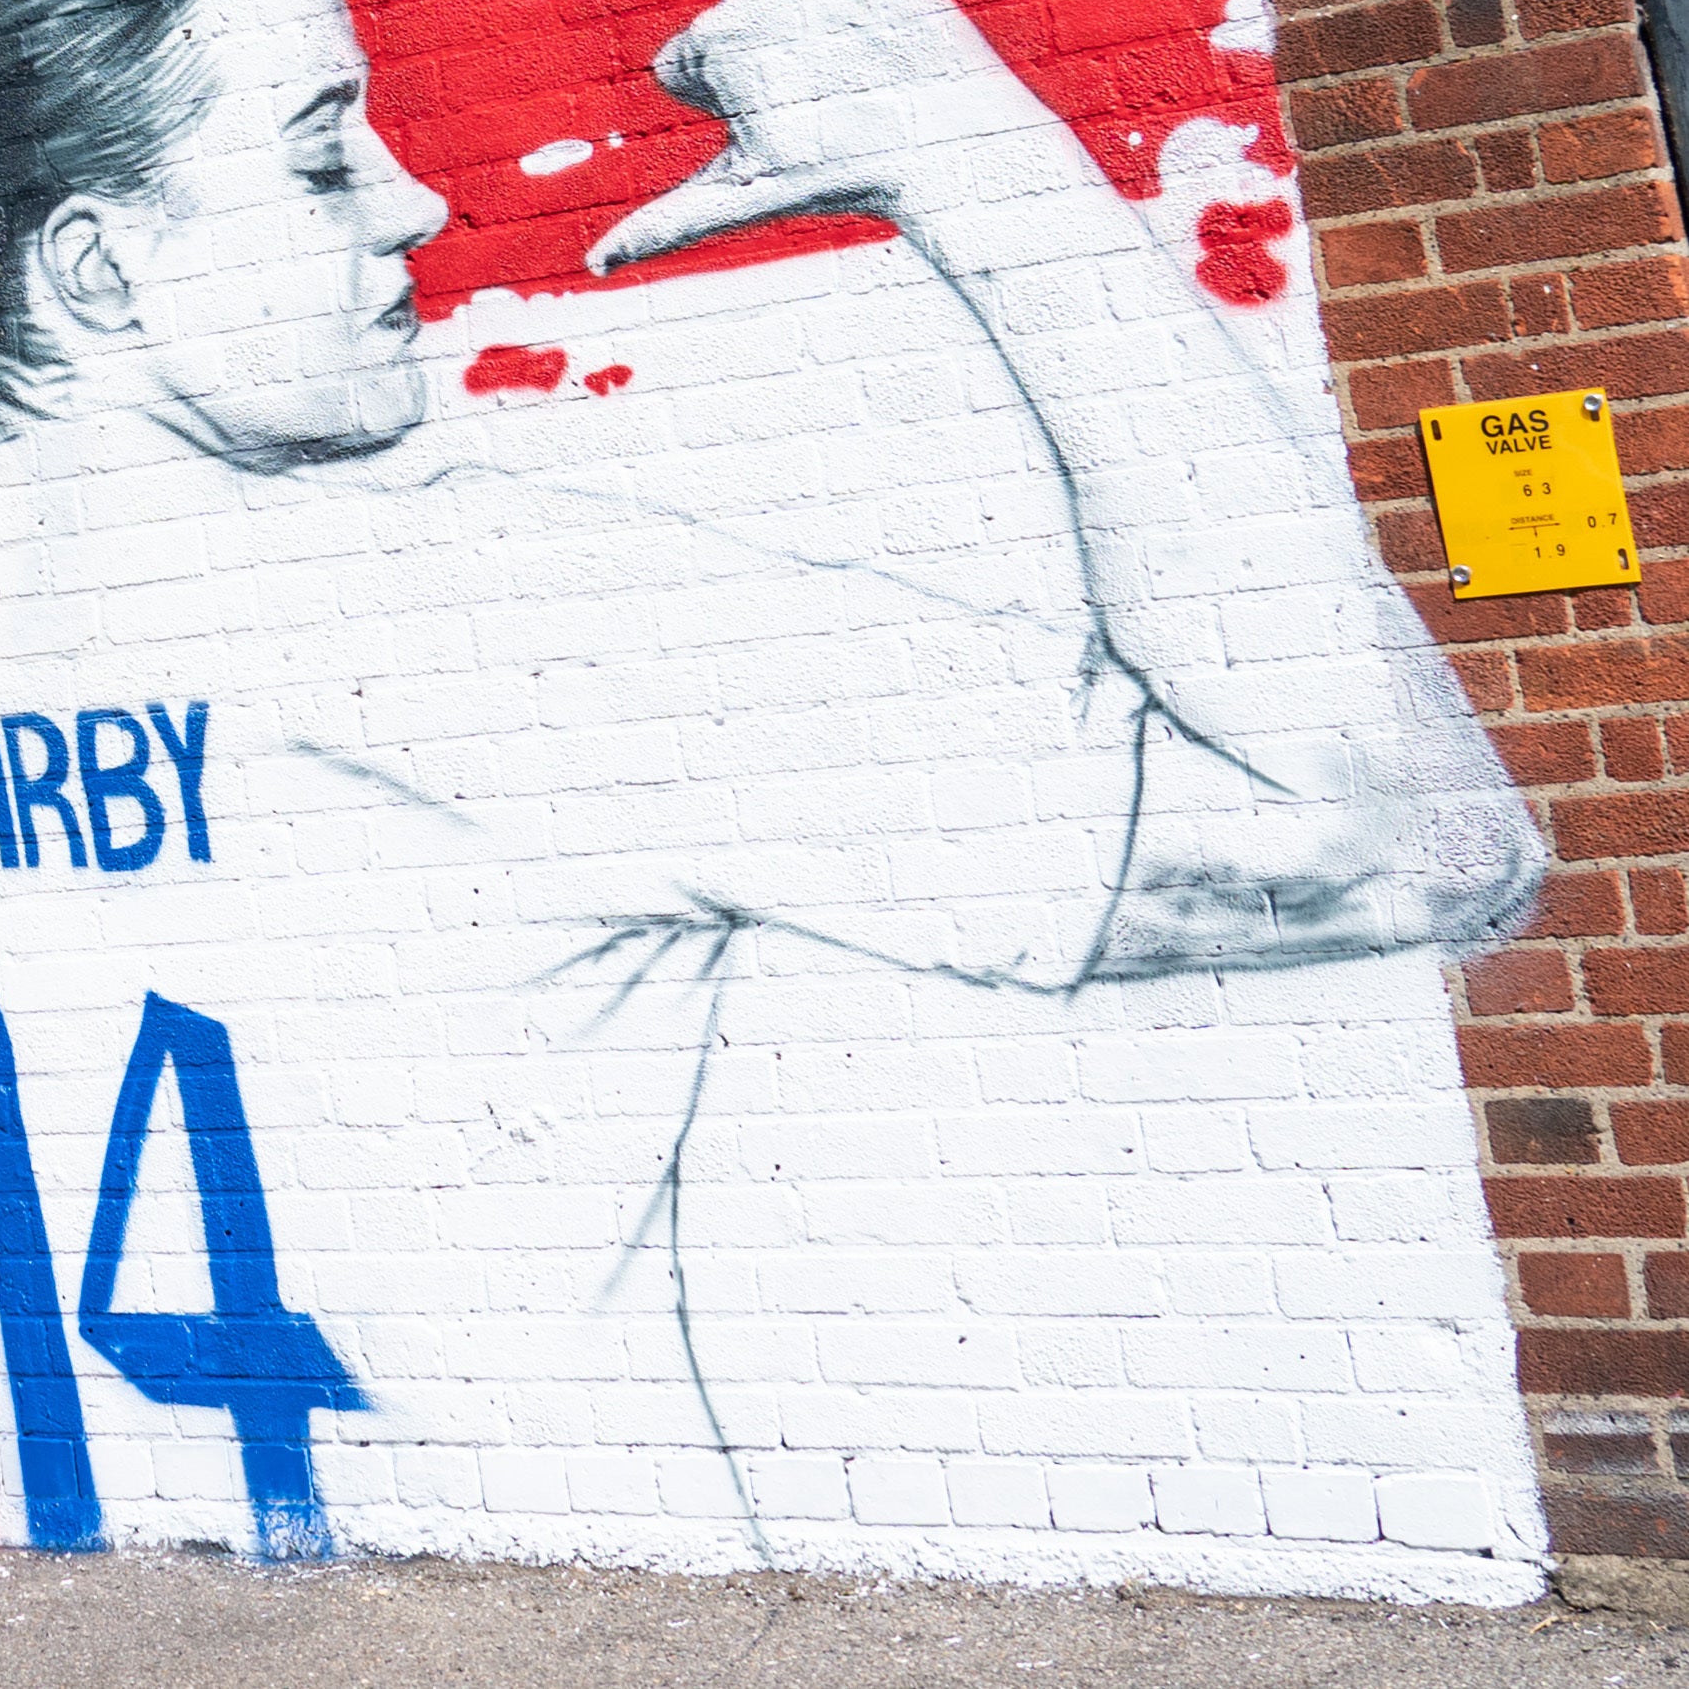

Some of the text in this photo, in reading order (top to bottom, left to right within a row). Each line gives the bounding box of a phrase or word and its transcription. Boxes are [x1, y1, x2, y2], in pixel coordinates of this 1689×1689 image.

[1480, 409, 1550, 438] GAS
[1486, 434, 1553, 455] VALVE
[1513, 469, 1533, 478] SIZE
[1510, 513, 1555, 524] DISTANCE
